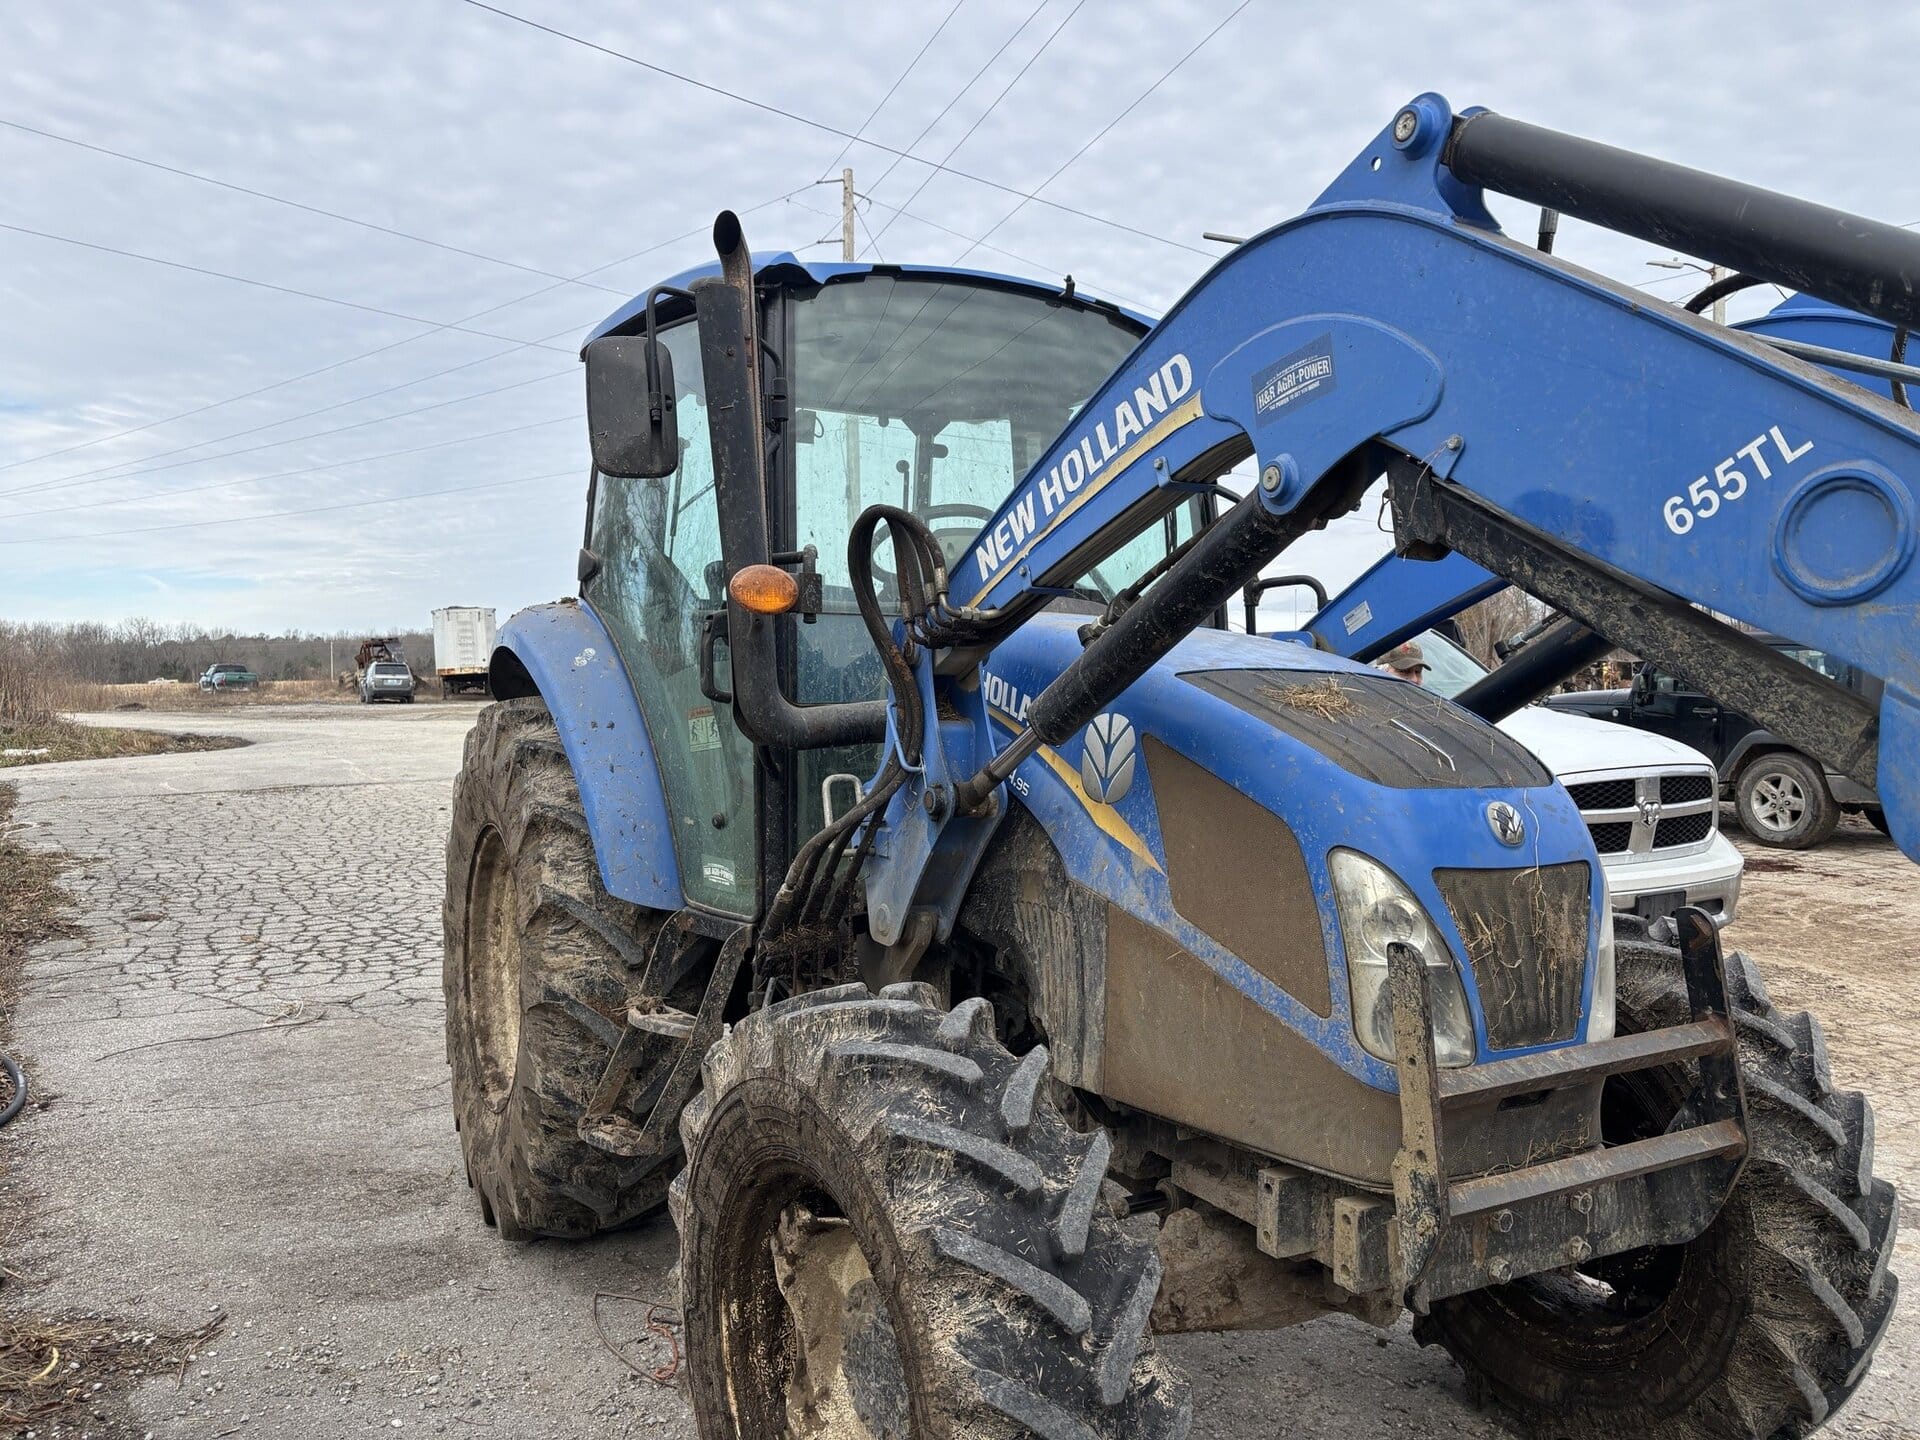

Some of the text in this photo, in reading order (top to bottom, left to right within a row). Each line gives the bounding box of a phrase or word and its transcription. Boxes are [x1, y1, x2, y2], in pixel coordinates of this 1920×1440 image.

[1277, 359, 1330, 395] AGRI-POWER
[975, 353, 1192, 582] NEW HOLLAND
[1663, 425, 1814, 535] 655TL
[982, 669, 1031, 726] HOLLA
